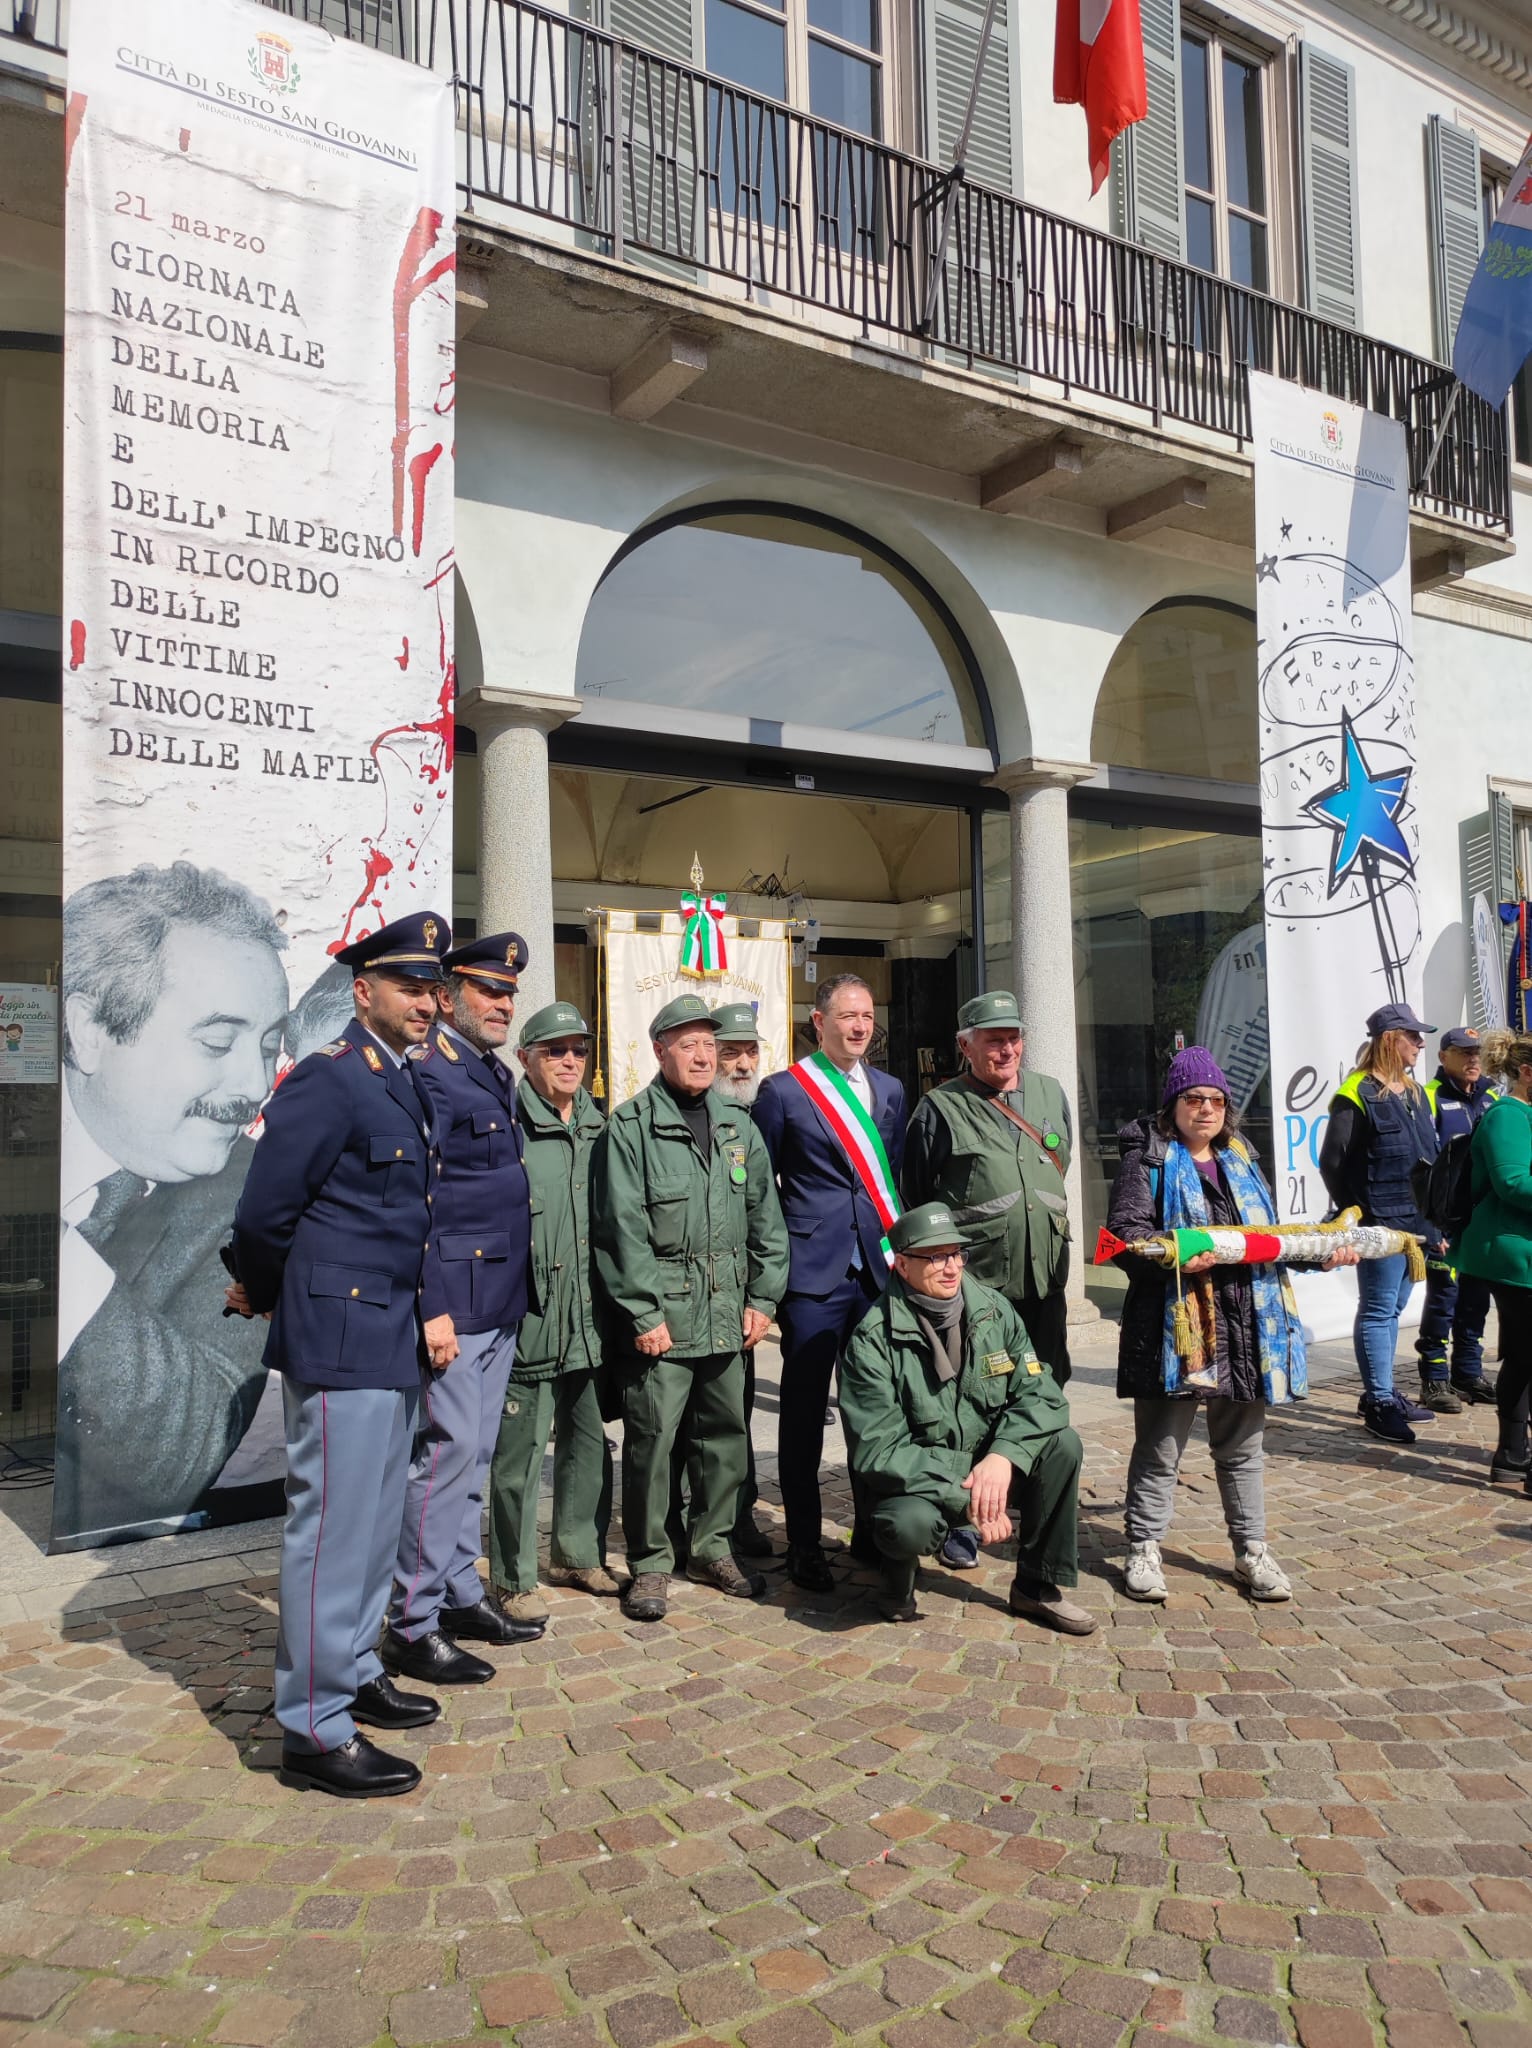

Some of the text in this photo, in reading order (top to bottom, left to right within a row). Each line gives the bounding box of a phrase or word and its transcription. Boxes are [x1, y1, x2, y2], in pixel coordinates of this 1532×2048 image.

[116, 47, 418, 165] CITTÀ DI SESTO SAN GIOVANNI
[197, 101, 241, 122] MEDAGLIA
[114, 190, 266, 255] 21 marzo
[110, 240, 300, 317] GIORNATA
[111, 288, 326, 369] NAZIONALE
[111, 336, 240, 394] DELLA
[111, 385, 290, 452] MEMORIA
[111, 432, 134, 464] E
[1308, 450, 1335, 467] SESTO
[1336, 459, 1352, 473] SAN
[1355, 465, 1395, 486] GIOVANNI
[111, 481, 405, 562] DELL' IMPEGNO
[110, 529, 340, 599] IN RICORDO
[110, 579, 241, 629] DELLE
[110, 628, 277, 681] VITTIME
[110, 677, 316, 733] INNOCENTI
[109, 727, 380, 785] DELLE MAFIE
[1288, 1176, 1307, 1216] 21
